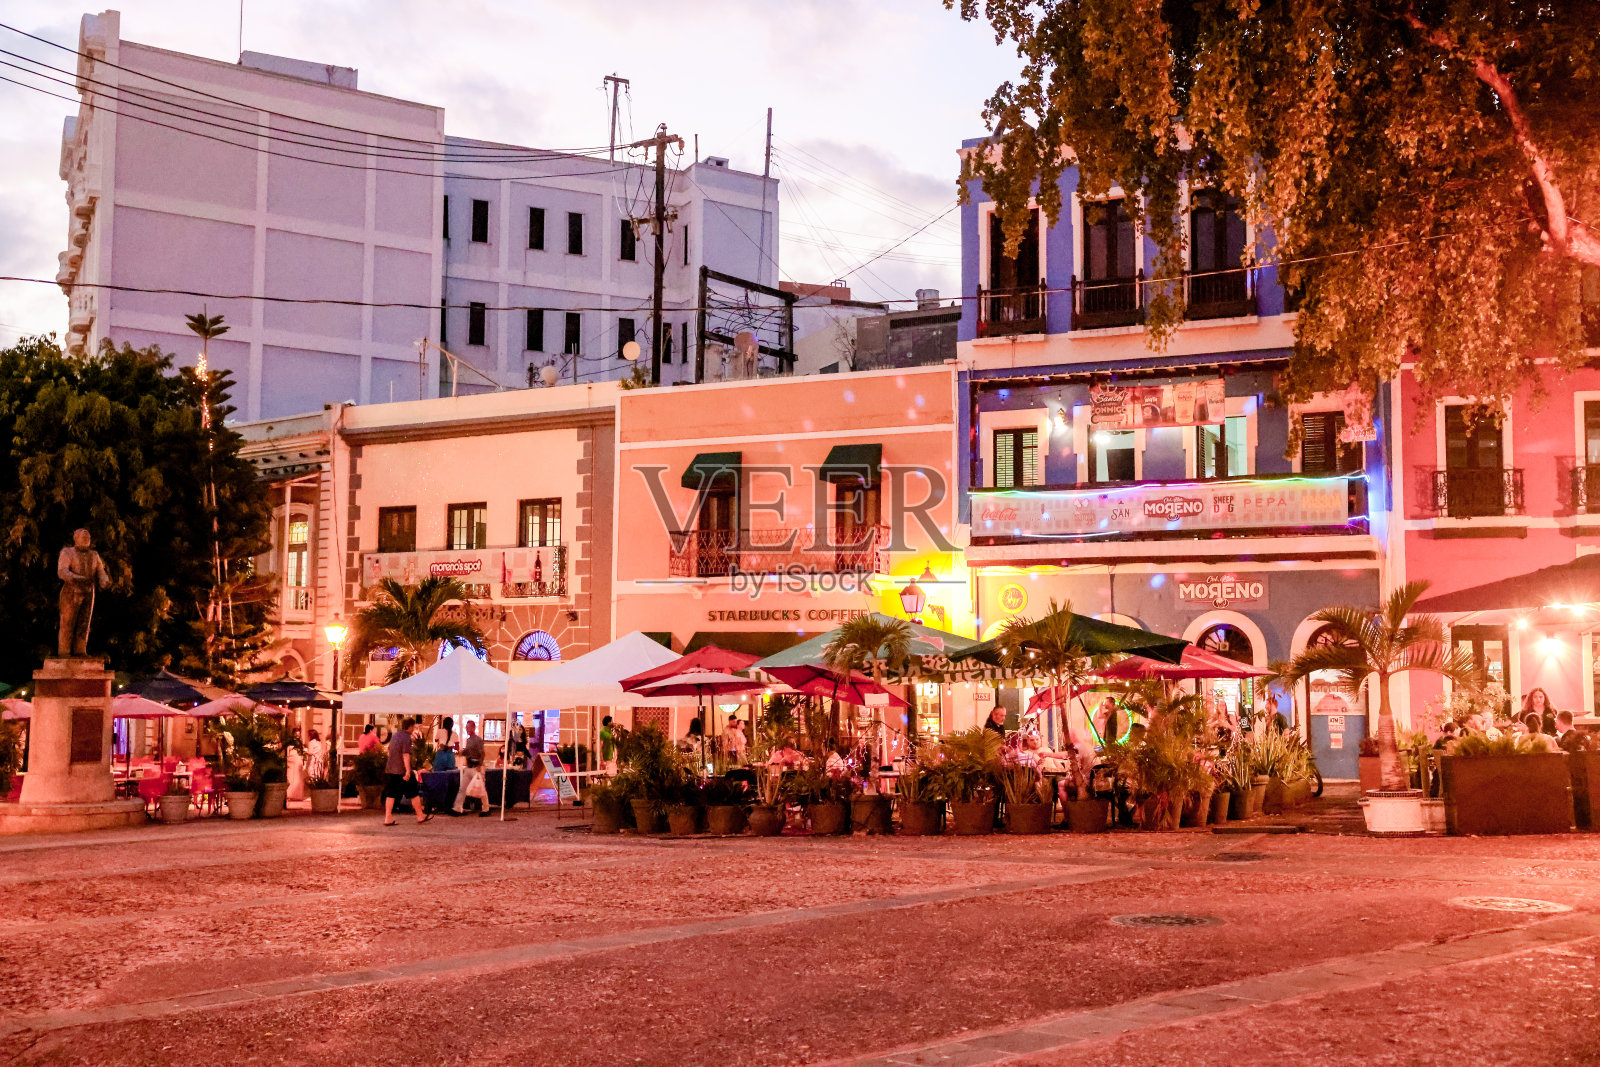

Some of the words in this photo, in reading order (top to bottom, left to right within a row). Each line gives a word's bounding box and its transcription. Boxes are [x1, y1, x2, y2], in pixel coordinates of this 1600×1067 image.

[1144, 501, 1203, 515] MORENO
[1244, 497, 1287, 508] PEPA
[1110, 507, 1130, 520] SAN
[463, 560, 481, 574] spot
[1179, 583, 1264, 599] MORENO
[708, 610, 800, 622] STARBUCKS
